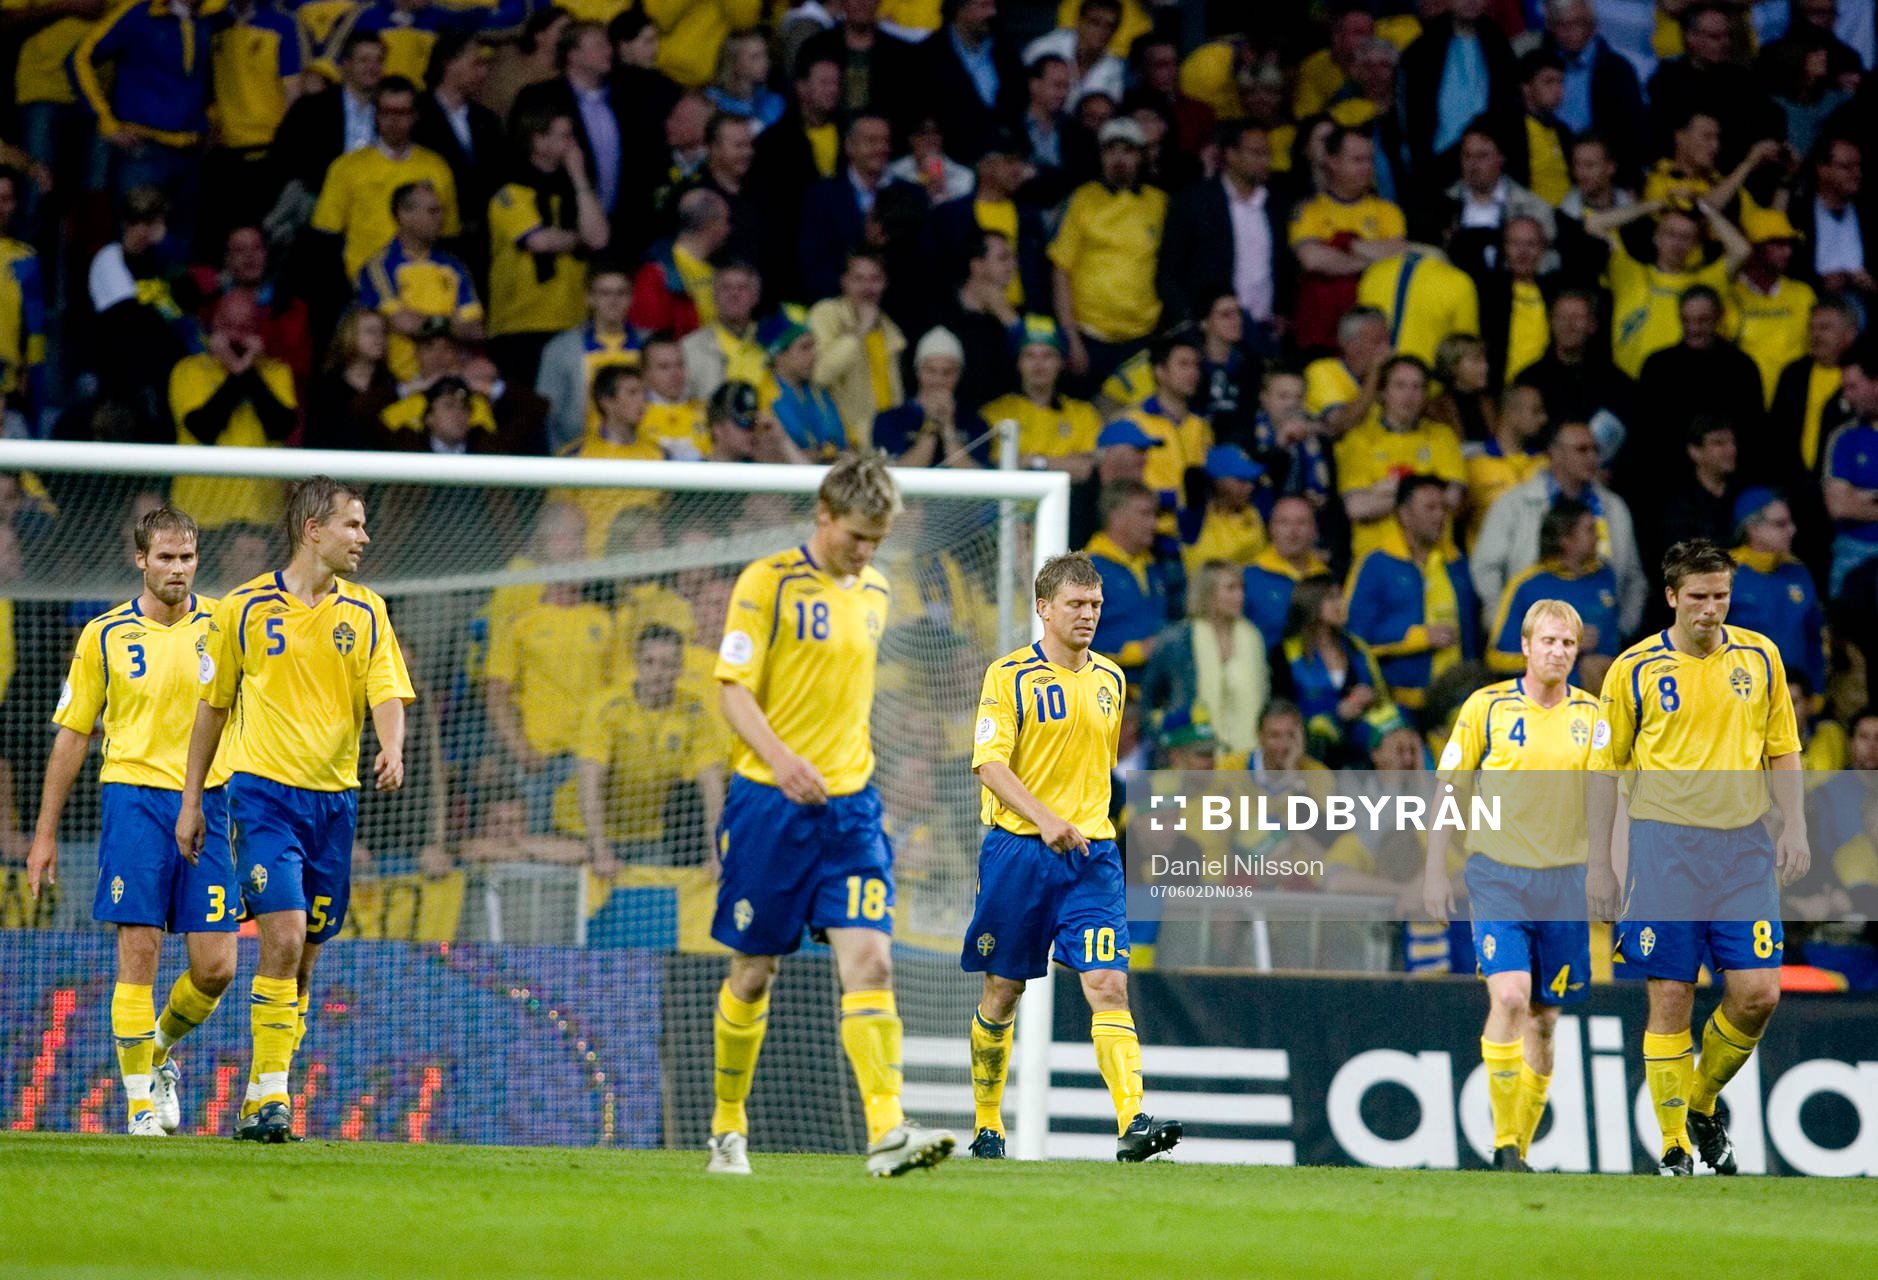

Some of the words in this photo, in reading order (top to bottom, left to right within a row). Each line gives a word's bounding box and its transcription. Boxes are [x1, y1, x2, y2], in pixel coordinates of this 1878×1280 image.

[266, 618, 286, 656] 5
[795, 601, 829, 640] 18
[127, 644, 147, 679] 3
[1034, 684, 1067, 723] 10
[1658, 676, 1680, 713] 8
[1509, 717, 1526, 747] 4
[206, 885, 225, 922] 3
[306, 895, 332, 933] 5
[847, 876, 887, 921] 18
[1084, 927, 1115, 963] 10
[1752, 920, 1773, 959] 8
[1550, 964, 1571, 998] 4
